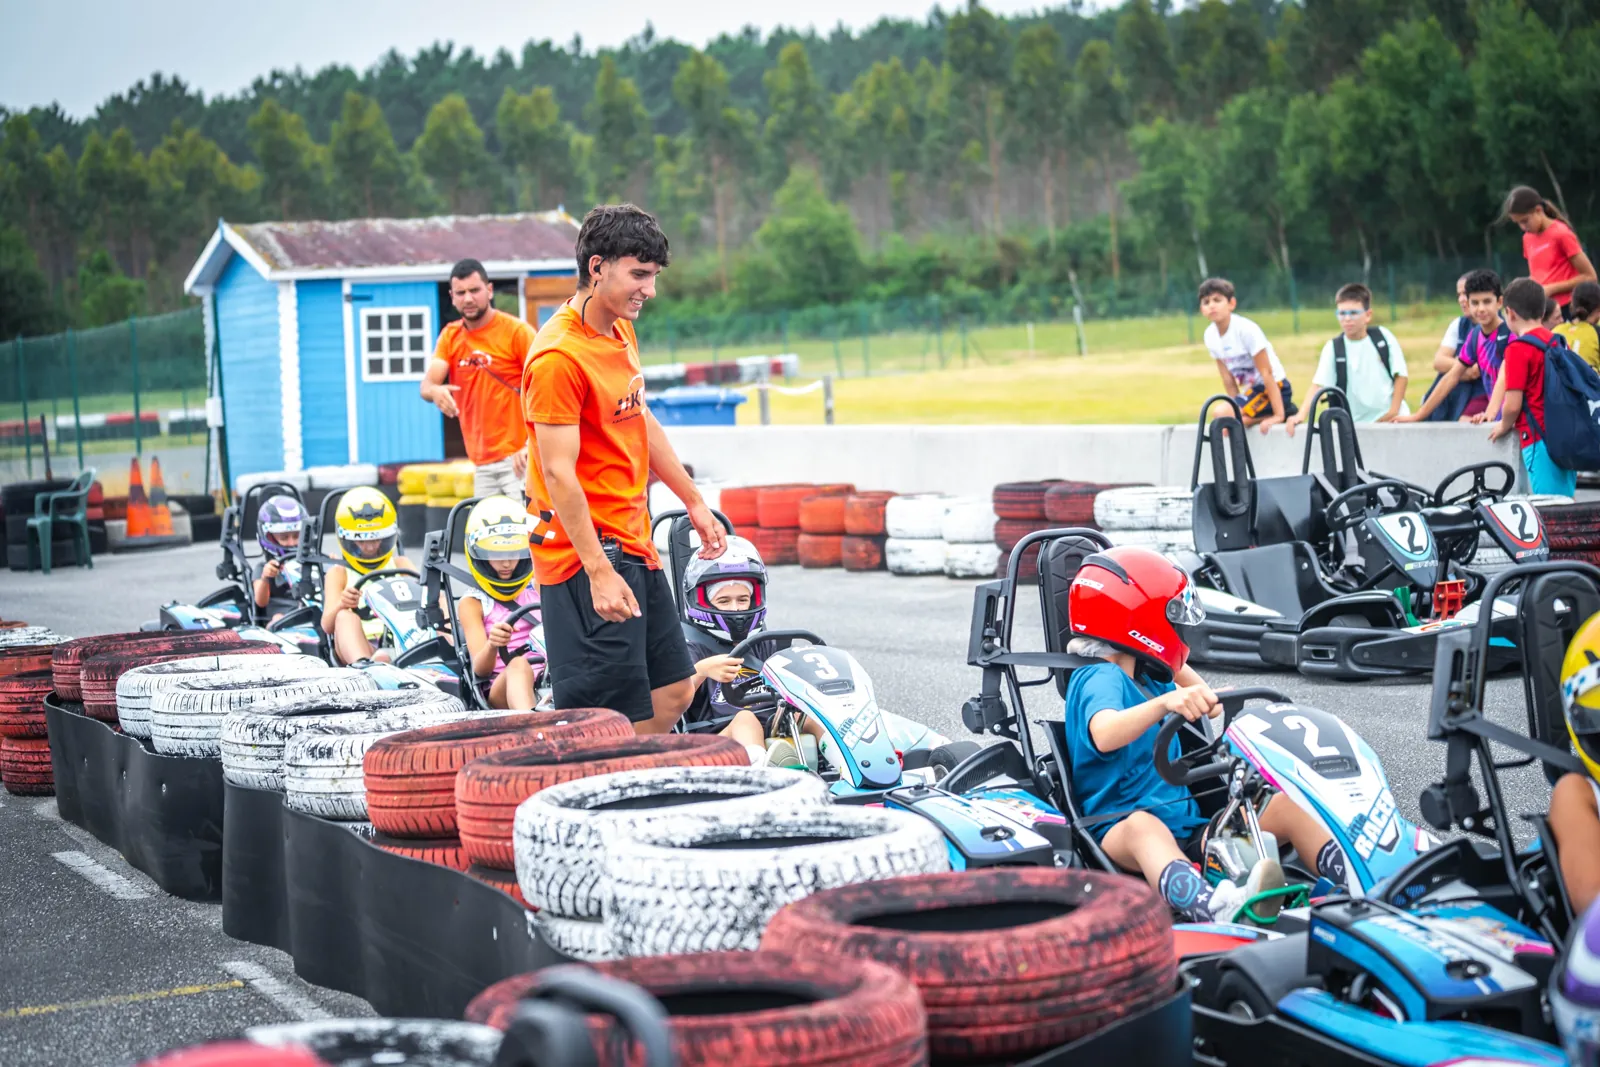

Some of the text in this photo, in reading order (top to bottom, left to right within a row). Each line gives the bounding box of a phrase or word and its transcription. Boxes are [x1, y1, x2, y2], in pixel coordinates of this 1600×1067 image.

[1398, 515, 1423, 551] 2
[1511, 503, 1534, 540] 2
[390, 581, 413, 601] 8
[802, 653, 839, 680] 3
[839, 718, 855, 740] ittle
[1282, 715, 1340, 757] 2
